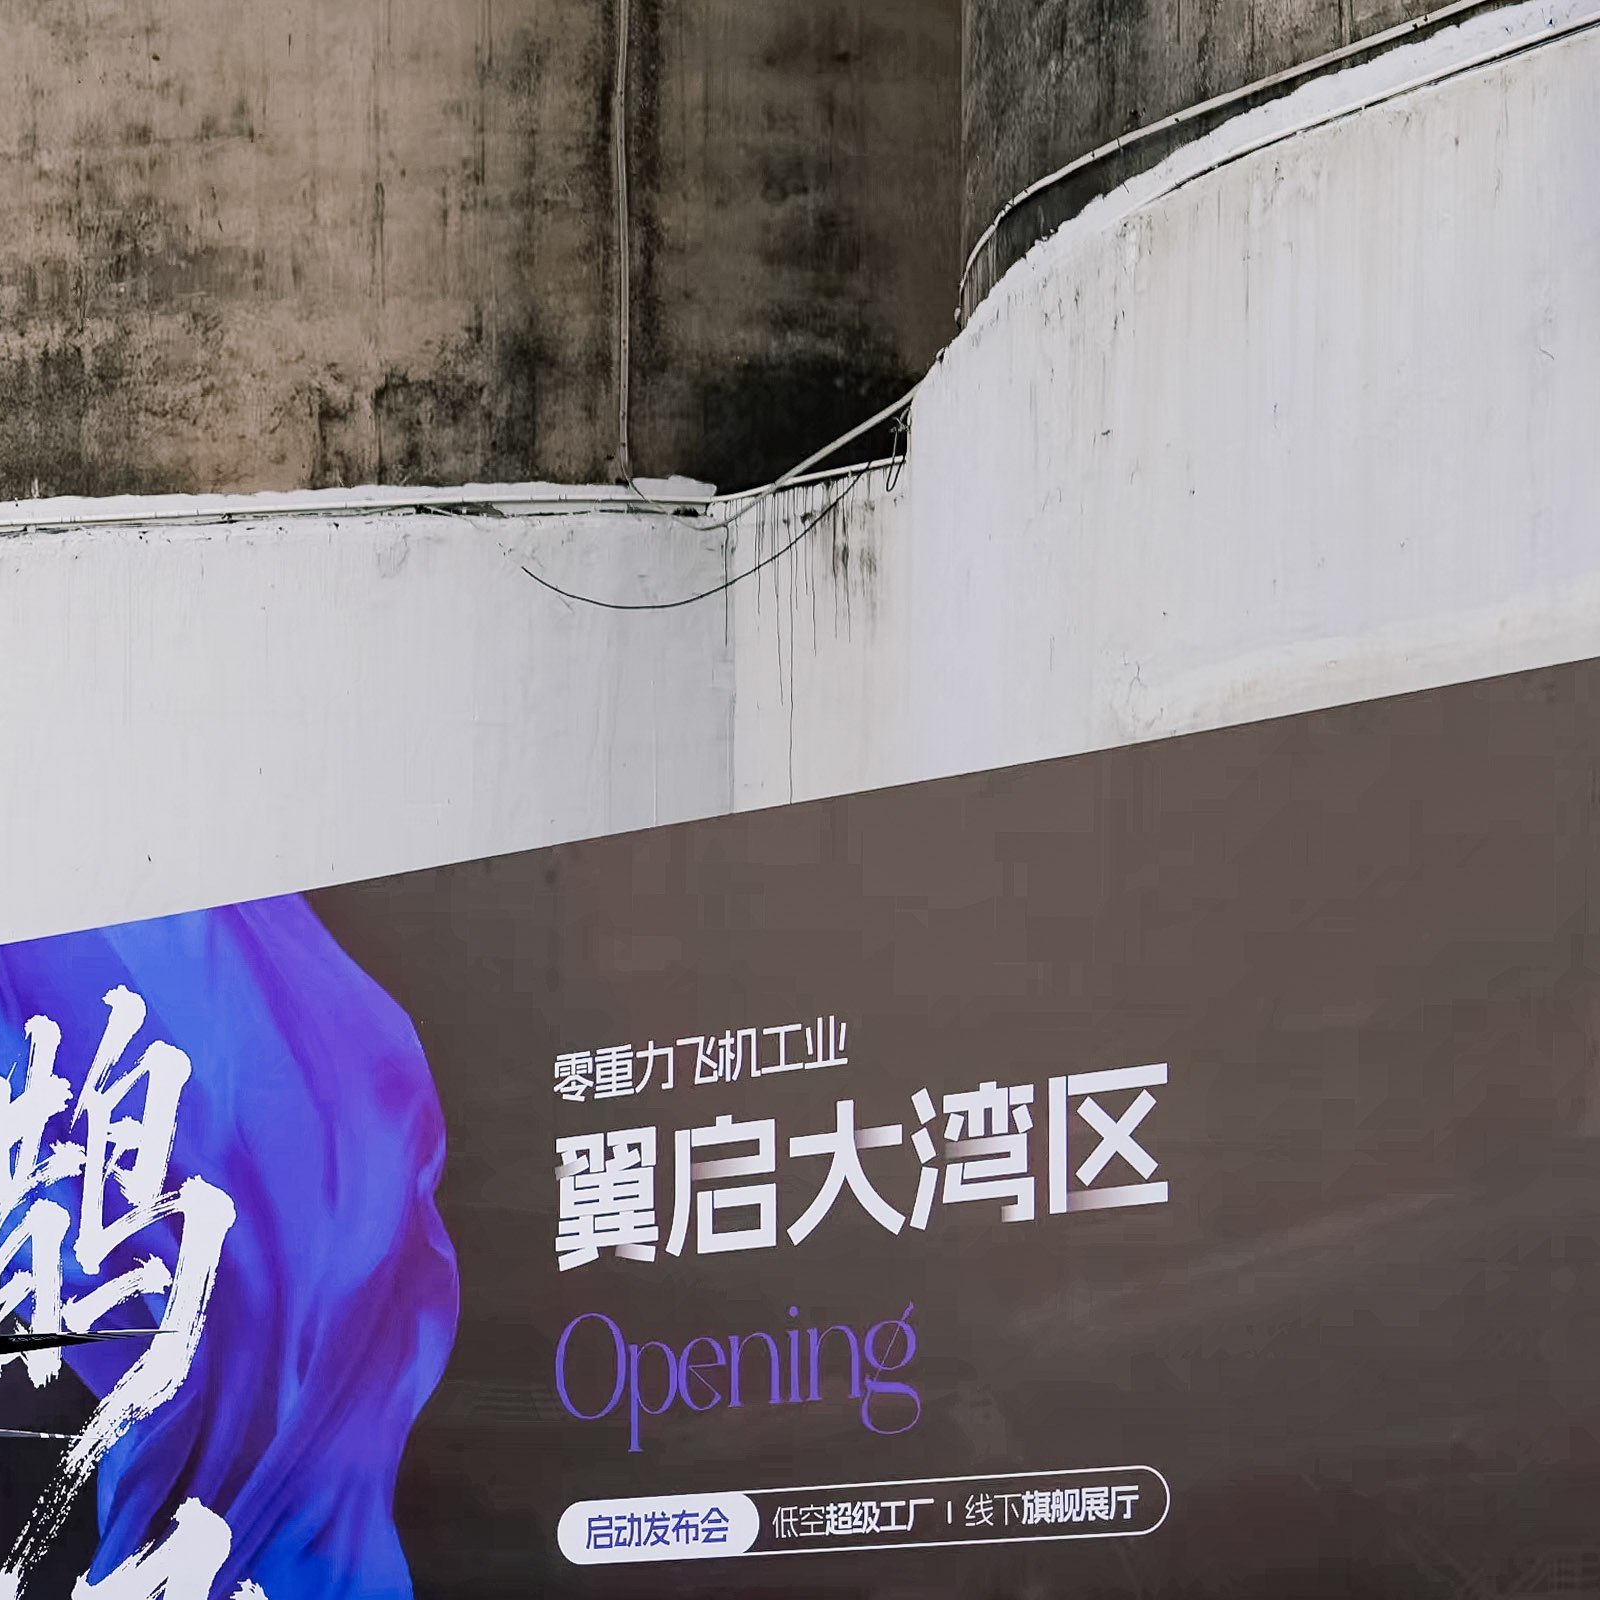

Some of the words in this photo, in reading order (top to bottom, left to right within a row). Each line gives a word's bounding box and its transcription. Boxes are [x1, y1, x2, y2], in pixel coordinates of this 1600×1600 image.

[553, 1015, 848, 1102] 零重力飞机工业
[555, 1062, 1169, 1272] 翼启大湾区
[554, 1302, 921, 1452] Opening
[585, 1507, 730, 1549] 启动发布会
[772, 1498, 936, 1539] 低空超级工厂
[965, 1485, 1140, 1526] 线下旗舰展厅
